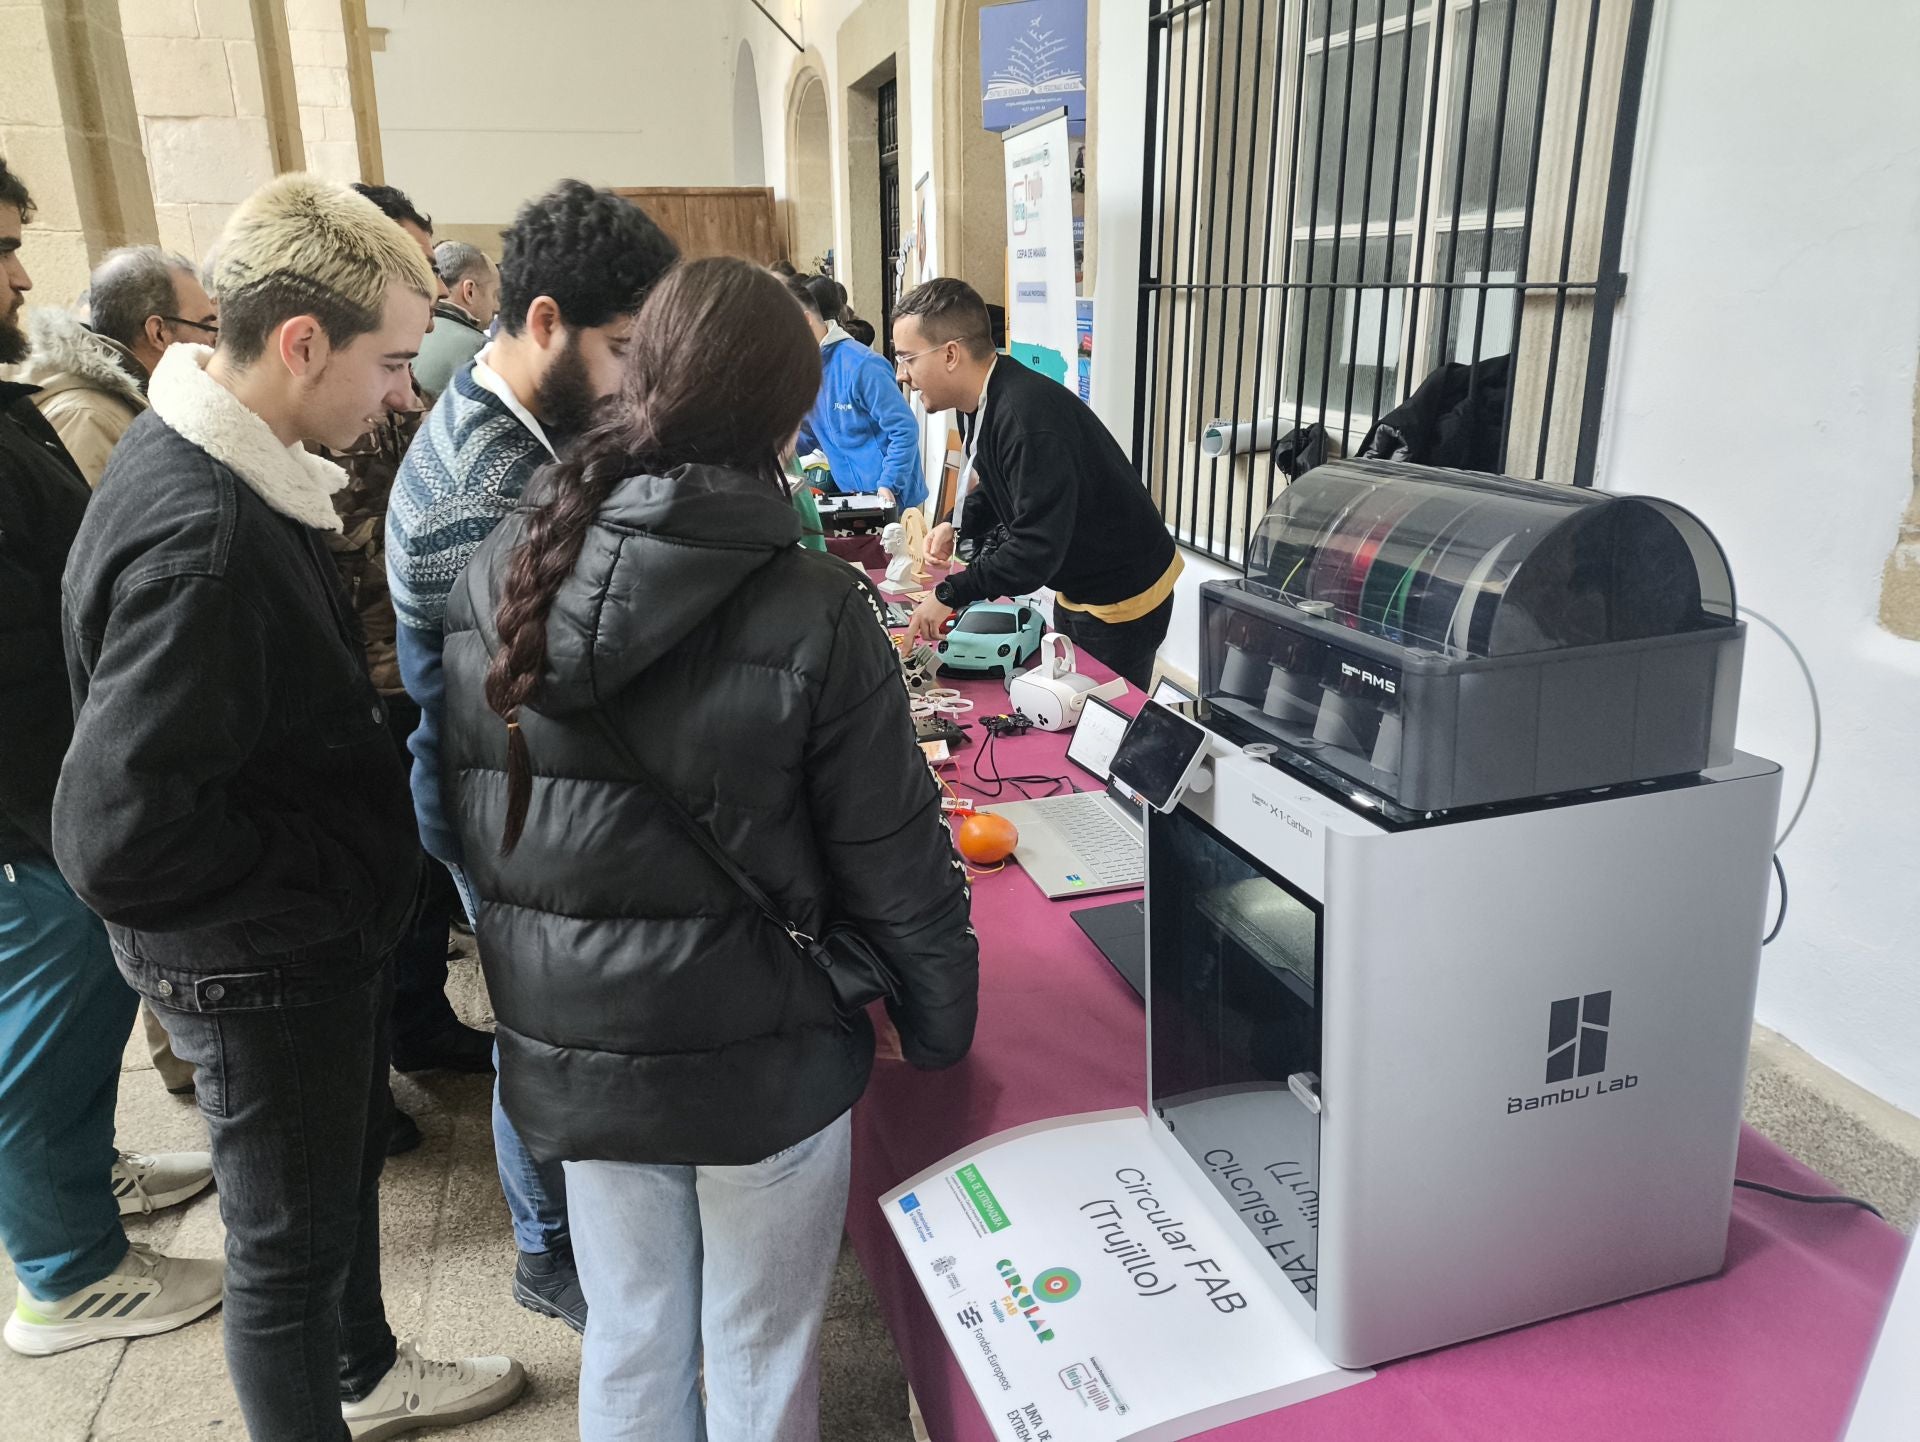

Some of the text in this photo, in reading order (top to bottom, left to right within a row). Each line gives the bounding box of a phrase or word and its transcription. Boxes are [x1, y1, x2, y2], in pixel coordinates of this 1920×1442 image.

[1361, 670, 1396, 694] AMS
[1507, 1074, 1639, 1115] Bambu Lab
[1080, 1199, 1177, 1297] (Trujillo)
[1115, 1168, 1248, 1314] Circular FAB
[989, 1299, 1005, 1324] Trujillo
[996, 1258, 1055, 1345] CIRCULAR
[1001, 1295, 1018, 1316] FAB
[973, 1327, 1012, 1391] Fondos Europeos
[1065, 1367, 1081, 1386] feria
[1083, 1377, 1111, 1412] Trujillo
[1021, 1402, 1053, 1442] JUNTA DE
